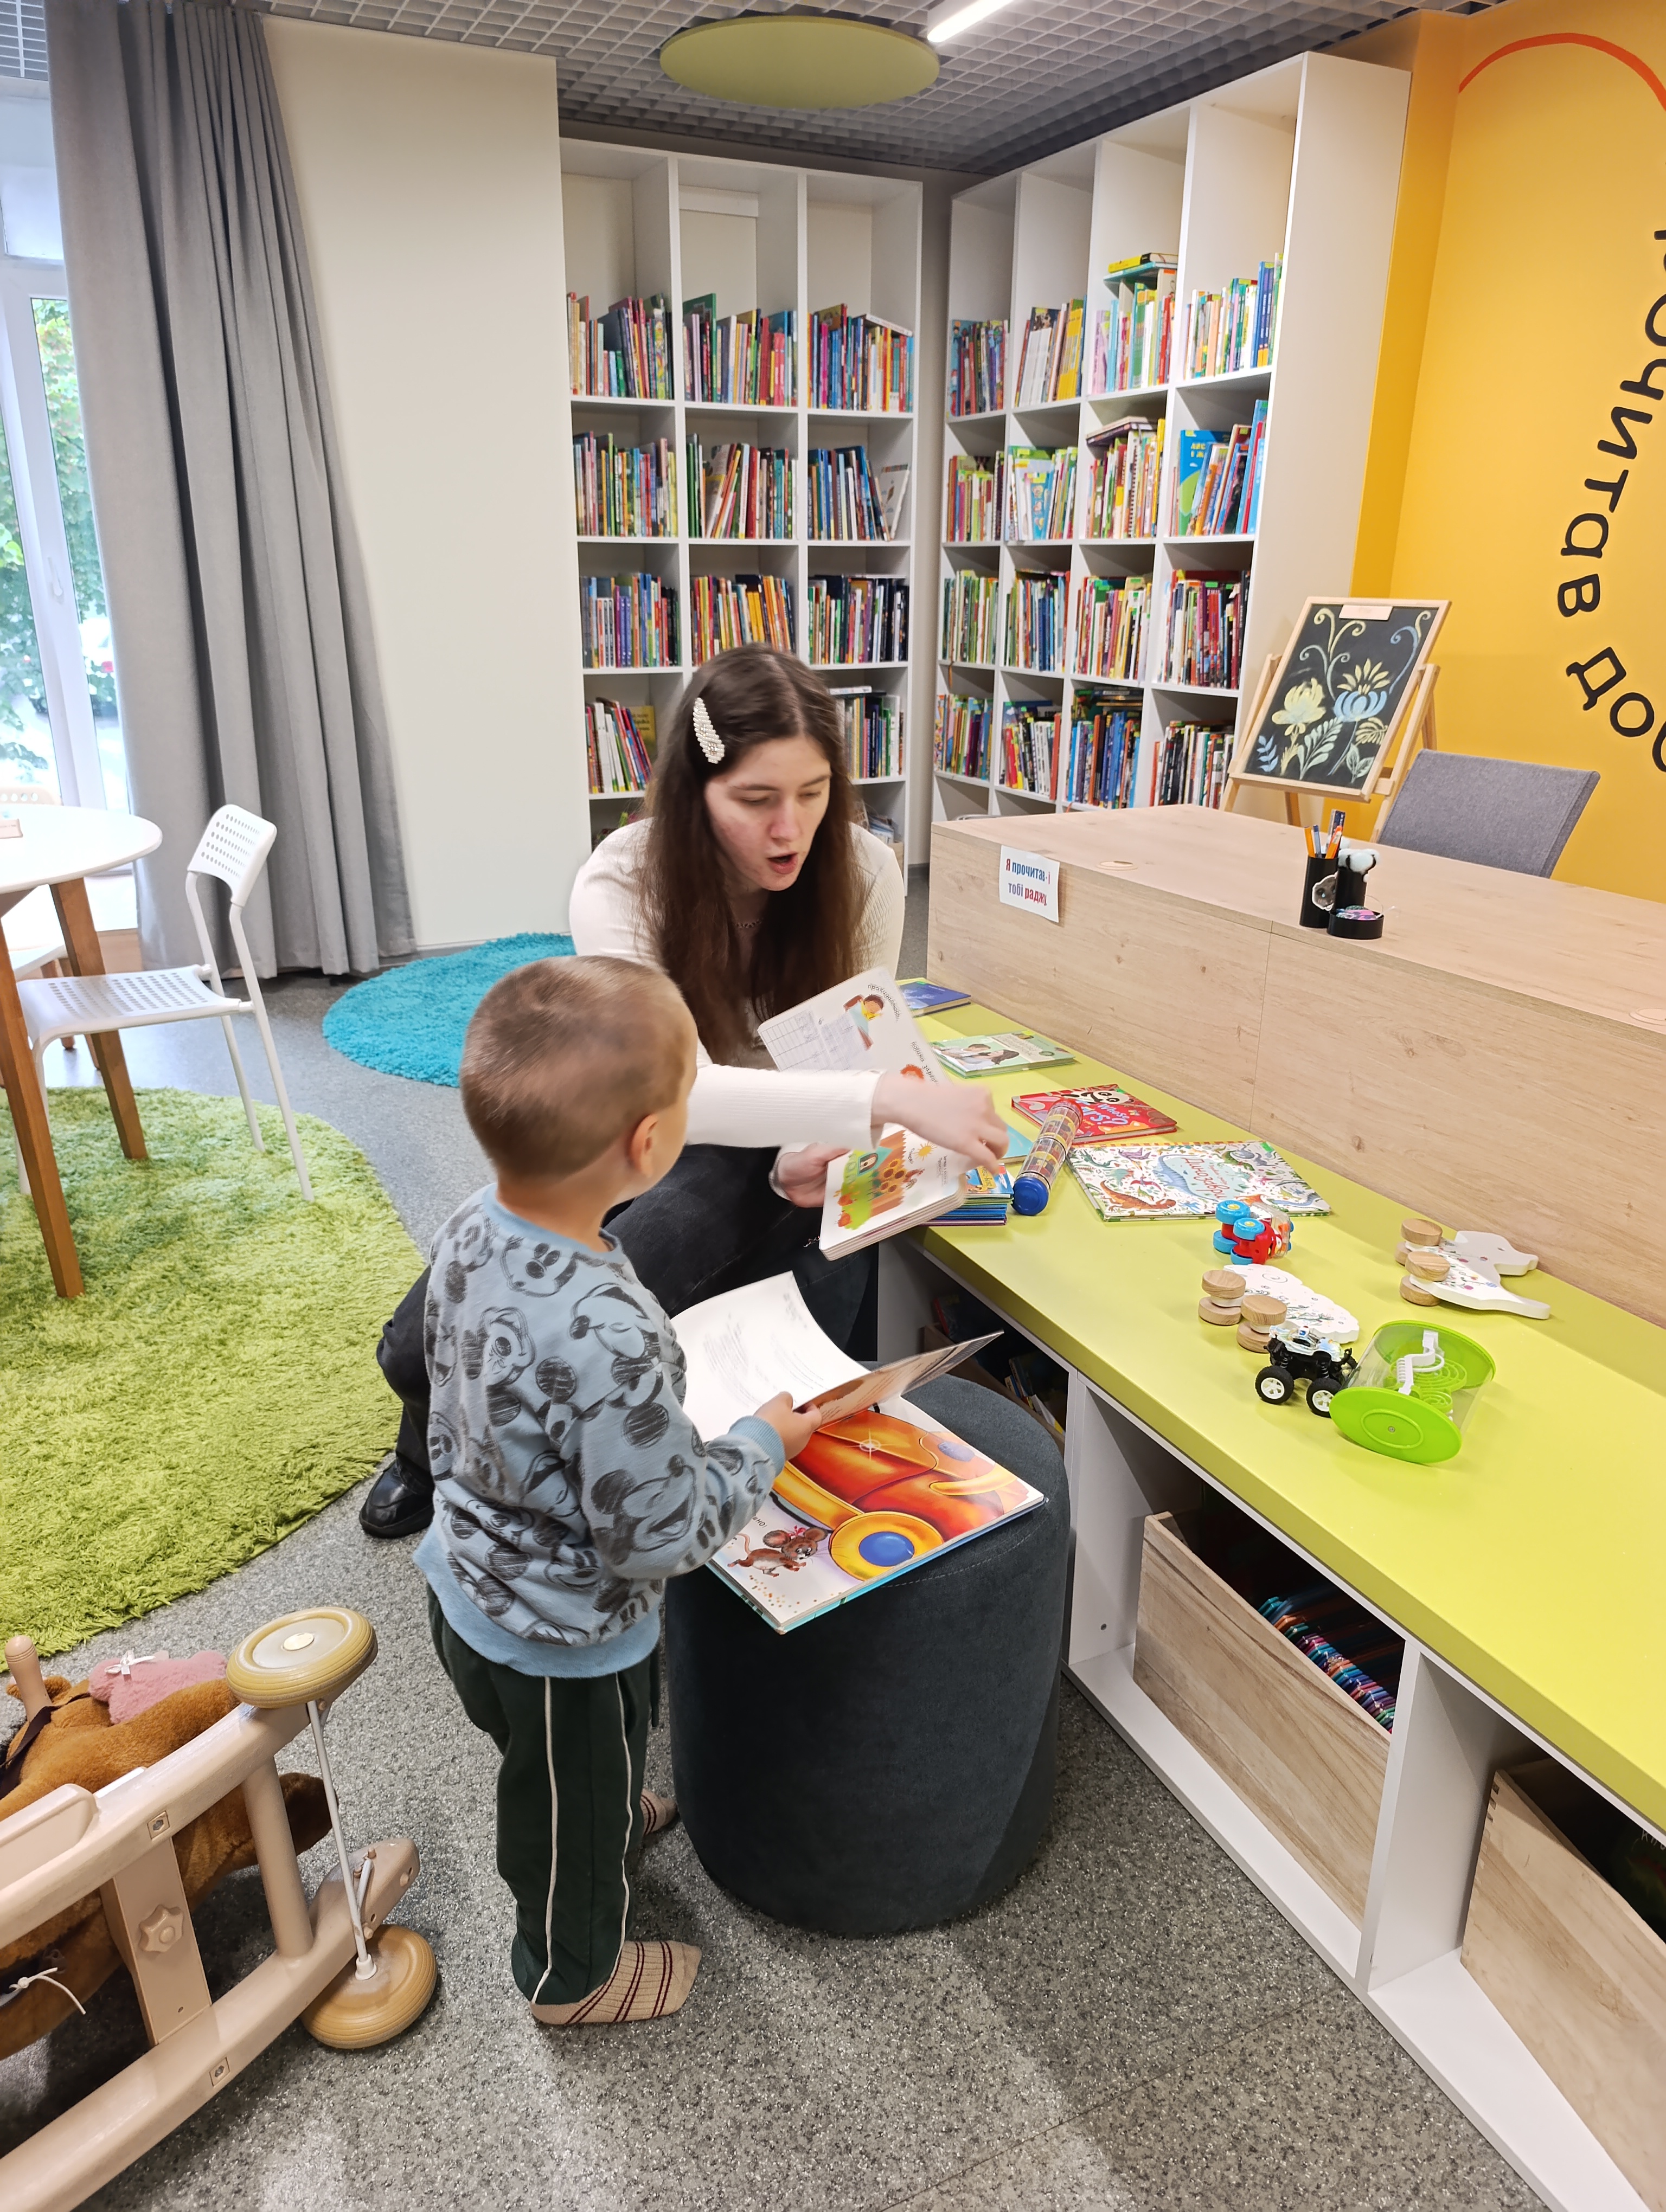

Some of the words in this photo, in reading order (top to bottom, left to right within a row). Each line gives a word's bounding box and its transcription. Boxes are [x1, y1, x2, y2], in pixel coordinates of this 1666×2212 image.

[1005, 858, 1011, 871] Я
[1012, 861, 1046, 882] прочитав
[1008, 883, 1023, 897] тобі
[1097, 1103, 1130, 1120] Whose
